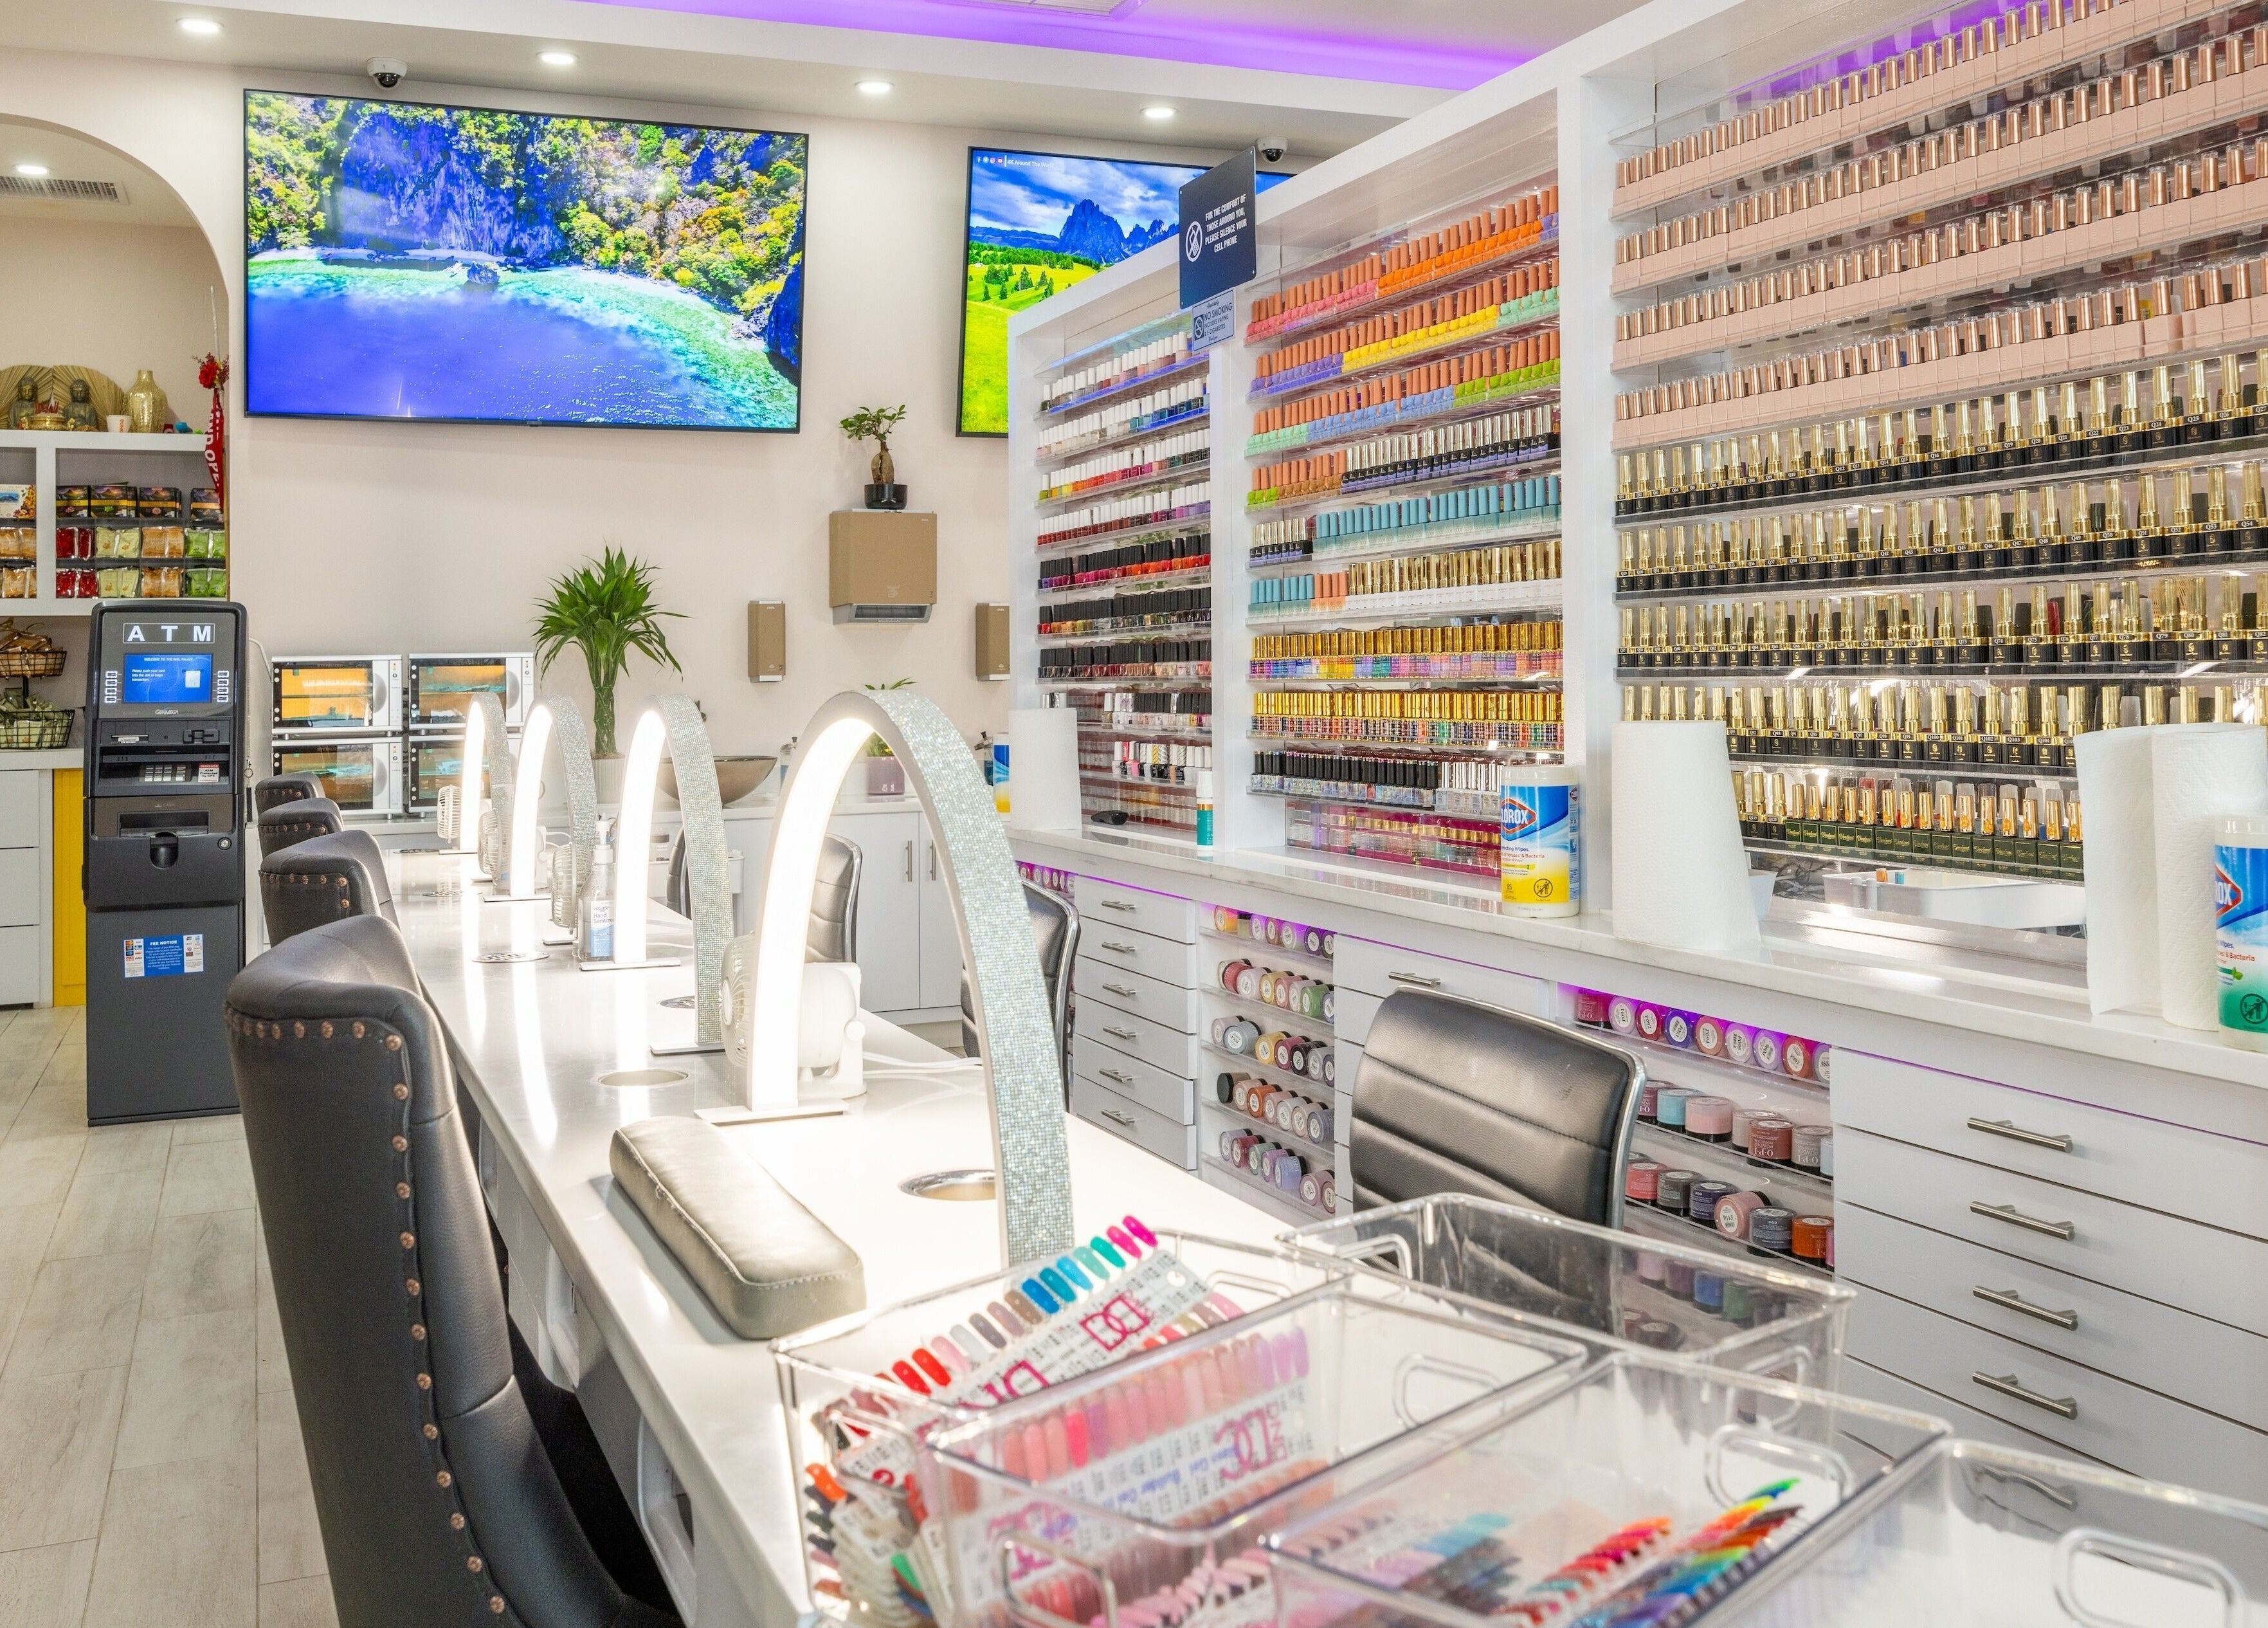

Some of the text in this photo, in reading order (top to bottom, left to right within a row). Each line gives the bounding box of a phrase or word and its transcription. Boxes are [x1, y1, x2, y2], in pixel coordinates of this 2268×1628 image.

[1221, 197, 1240, 214] COMFORT
[1240, 194, 1246, 204] OF
[1206, 207, 1245, 233] THOSE AROUND YOU,
[1205, 218, 1247, 246] PLEASE SILENCE YOUR
[1214, 235, 1237, 253] CELL PHONE
[1204, 302, 1232, 322] NO SMOKING
[127, 625, 211, 641] ATM
[1501, 808, 1529, 825] LOROX
[2229, 952, 2255, 962] Bacteria
